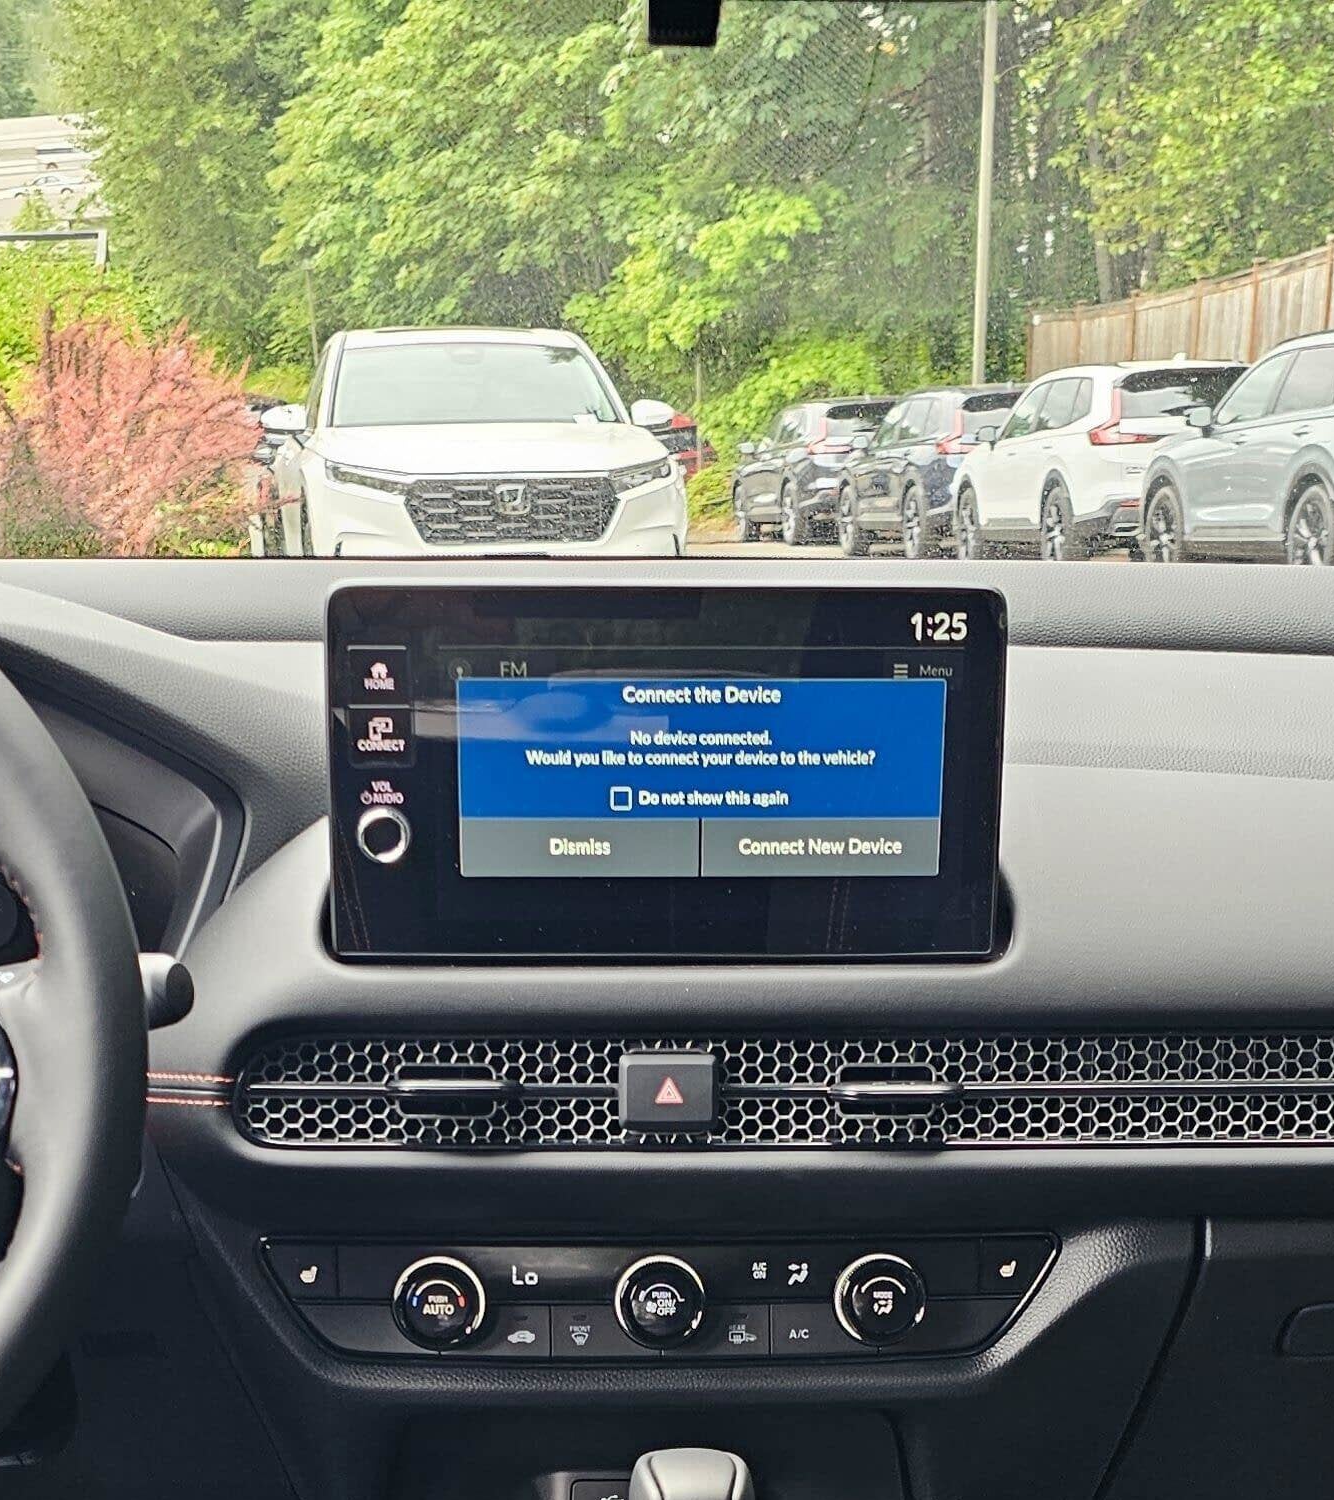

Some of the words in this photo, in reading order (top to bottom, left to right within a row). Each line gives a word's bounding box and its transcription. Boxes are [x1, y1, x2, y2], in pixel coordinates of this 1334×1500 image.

[910, 611, 968, 641] 1:25
[499, 661, 528, 677] FM
[919, 665, 953, 677] Menu
[363, 678, 395, 690] HOME
[622, 685, 691, 704] Connect
[693, 686, 722, 704] the
[724, 686, 782, 704] Device
[630, 731, 652, 746] No
[653, 730, 697, 746] device
[698, 730, 773, 746] connected.
[357, 739, 406, 751] CONNECT
[525, 750, 572, 766] Would
[573, 753, 600, 768] you
[602, 750, 626, 766] like
[628, 752, 643, 766] to
[645, 752, 700, 766] connect
[701, 753, 733, 768] your
[735, 751, 778, 766] device
[780, 752, 796, 766] to
[797, 751, 820, 766] the
[822, 750, 877, 766] vehicle?
[371, 781, 393, 793] VOL
[373, 792, 404, 804] AUDIO
[638, 790, 660, 806] Do
[662, 791, 685, 806] not
[686, 790, 723, 806] show
[725, 790, 750, 806] this
[752, 791, 789, 808] again
[549, 838, 611, 856] Dismiss
[738, 838, 804, 855] Connect
[808, 838, 845, 855] New
[848, 838, 902, 855] Device
[752, 1262, 767, 1271] A/C
[511, 1264, 539, 1286] Lo
[753, 1271, 767, 1280] ON
[427, 1295, 449, 1304] PUSH
[651, 1291, 672, 1299] PUSH
[422, 1303, 455, 1316] AUTO
[657, 1299, 677, 1308] ON/
[657, 1307, 677, 1316] OFF
[569, 1325, 592, 1333] FRONT
[788, 1329, 810, 1339] A/C
